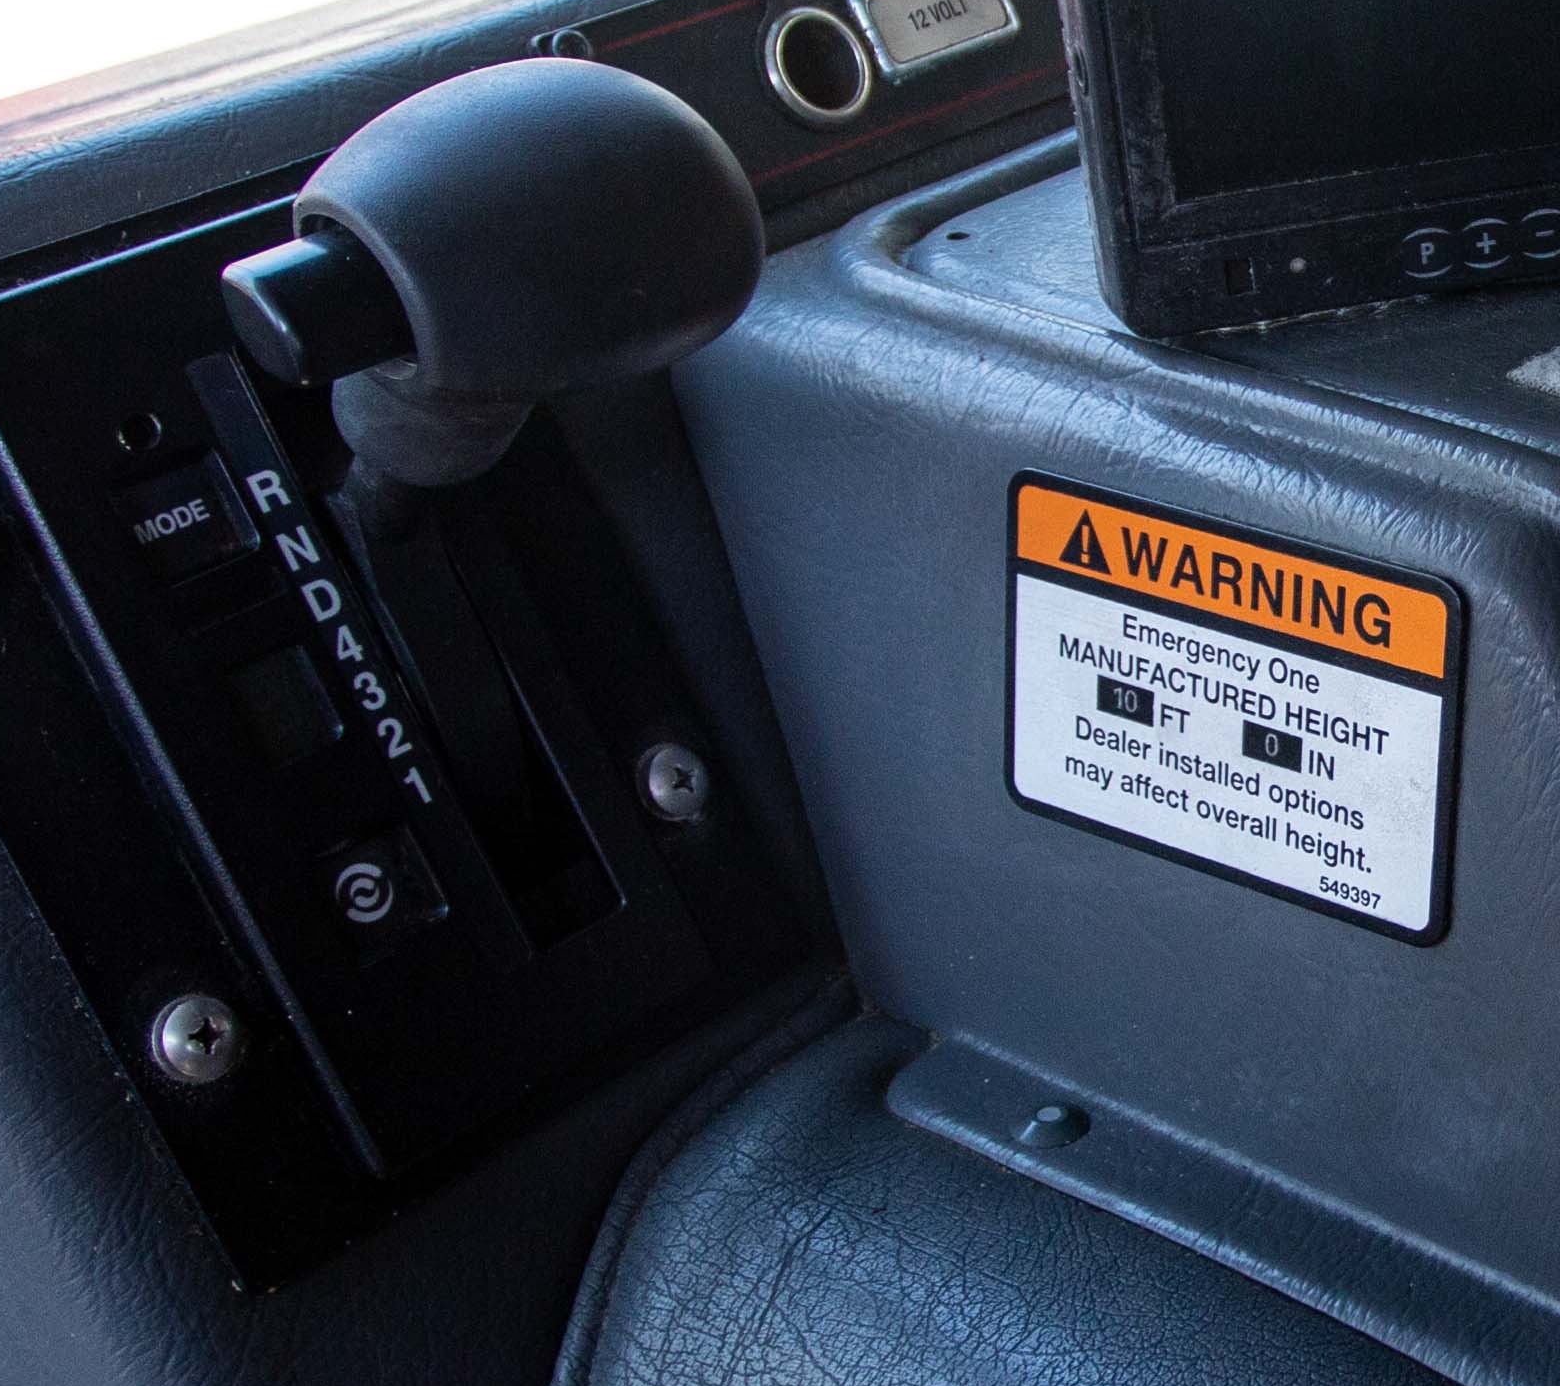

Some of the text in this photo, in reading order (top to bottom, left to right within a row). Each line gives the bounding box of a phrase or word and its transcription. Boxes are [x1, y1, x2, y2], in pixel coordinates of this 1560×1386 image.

[907, 10, 930, 32] 12
[1420, 243, 1435, 265] P
[246, 469, 292, 514] R
[133, 497, 211, 545] MODE
[275, 525, 321, 573] N
[300, 579, 342, 622] D
[1122, 527, 1392, 648] WARNING
[336, 626, 364, 663] 4
[1122, 614, 1320, 694] Emergency One
[353, 671, 387, 711] 3
[1059, 634, 1390, 755] MANUFACTURED HEIGHT
[377, 718, 412, 760] 2
[1112, 687, 1335, 780] 10 FT 0 IN
[404, 766, 433, 804] 1
[1075, 716, 1365, 830] Dealer installed options
[1065, 756, 1372, 875] may affect overall height.
[1319, 876, 1382, 910] 549397
